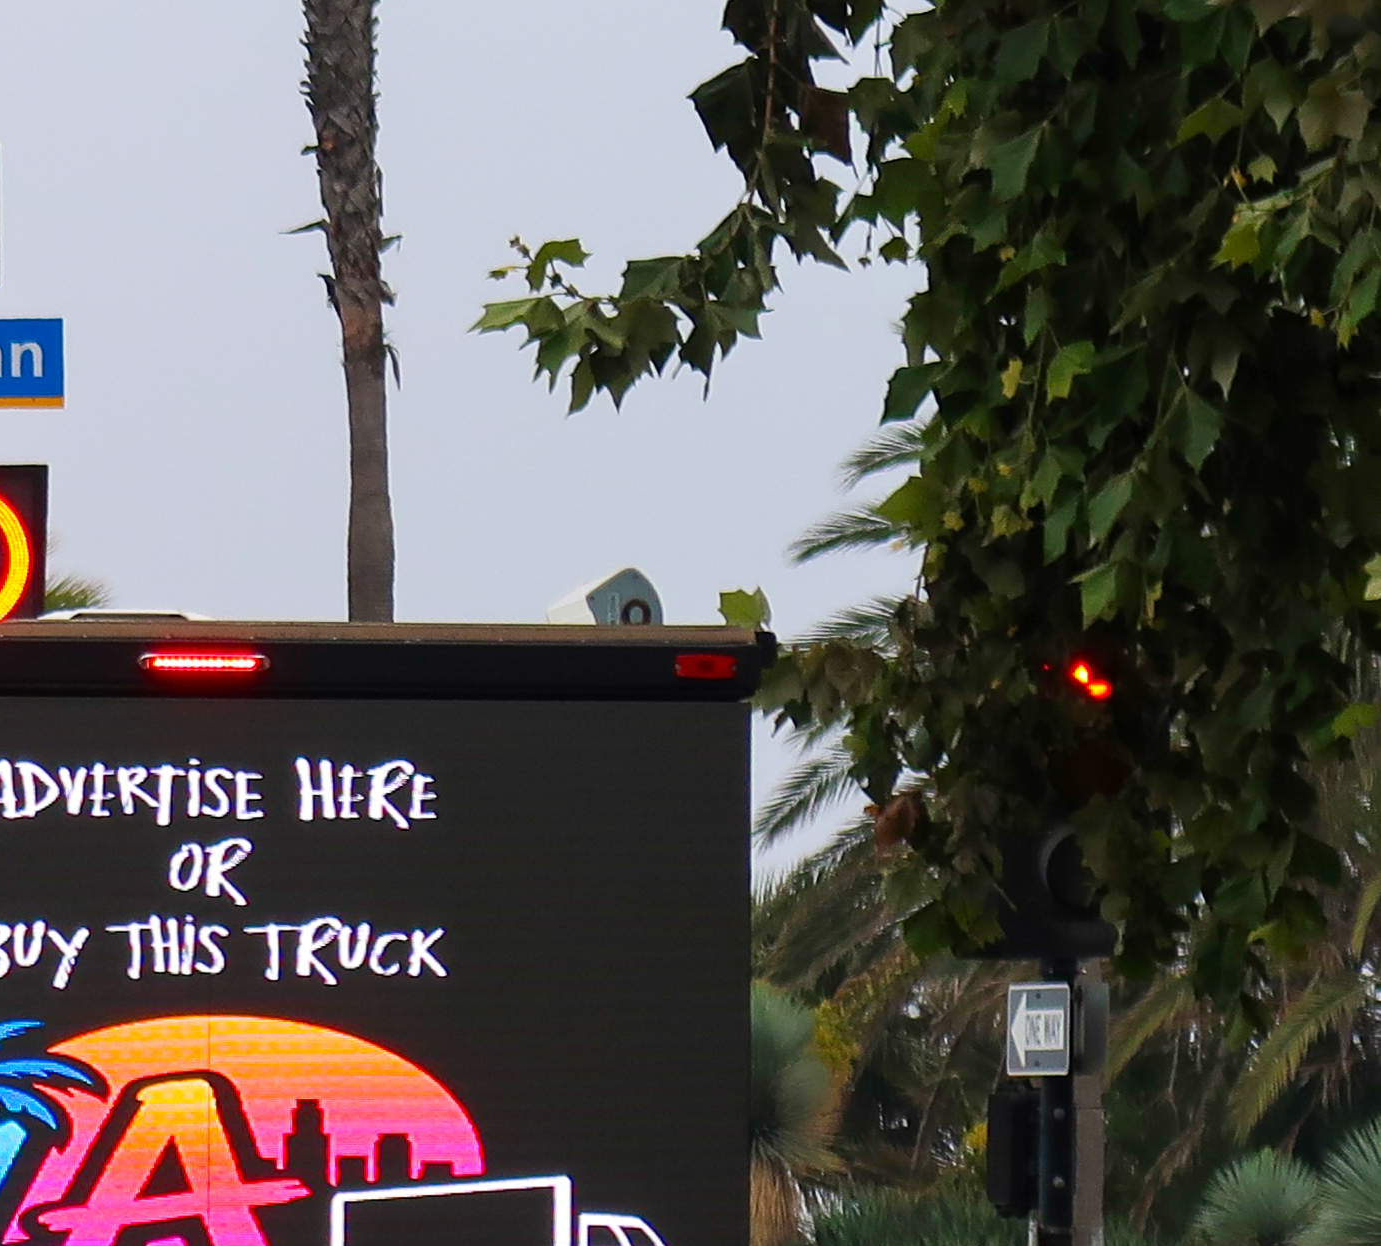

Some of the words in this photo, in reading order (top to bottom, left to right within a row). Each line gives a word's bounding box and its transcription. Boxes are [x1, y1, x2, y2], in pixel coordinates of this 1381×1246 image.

[296, 757, 440, 829] HERE
[167, 837, 255, 905] OR
[243, 915, 448, 985] TRUCK
[1027, 1014, 1041, 1044] ONE
[1044, 1014, 1062, 1044] WAY
